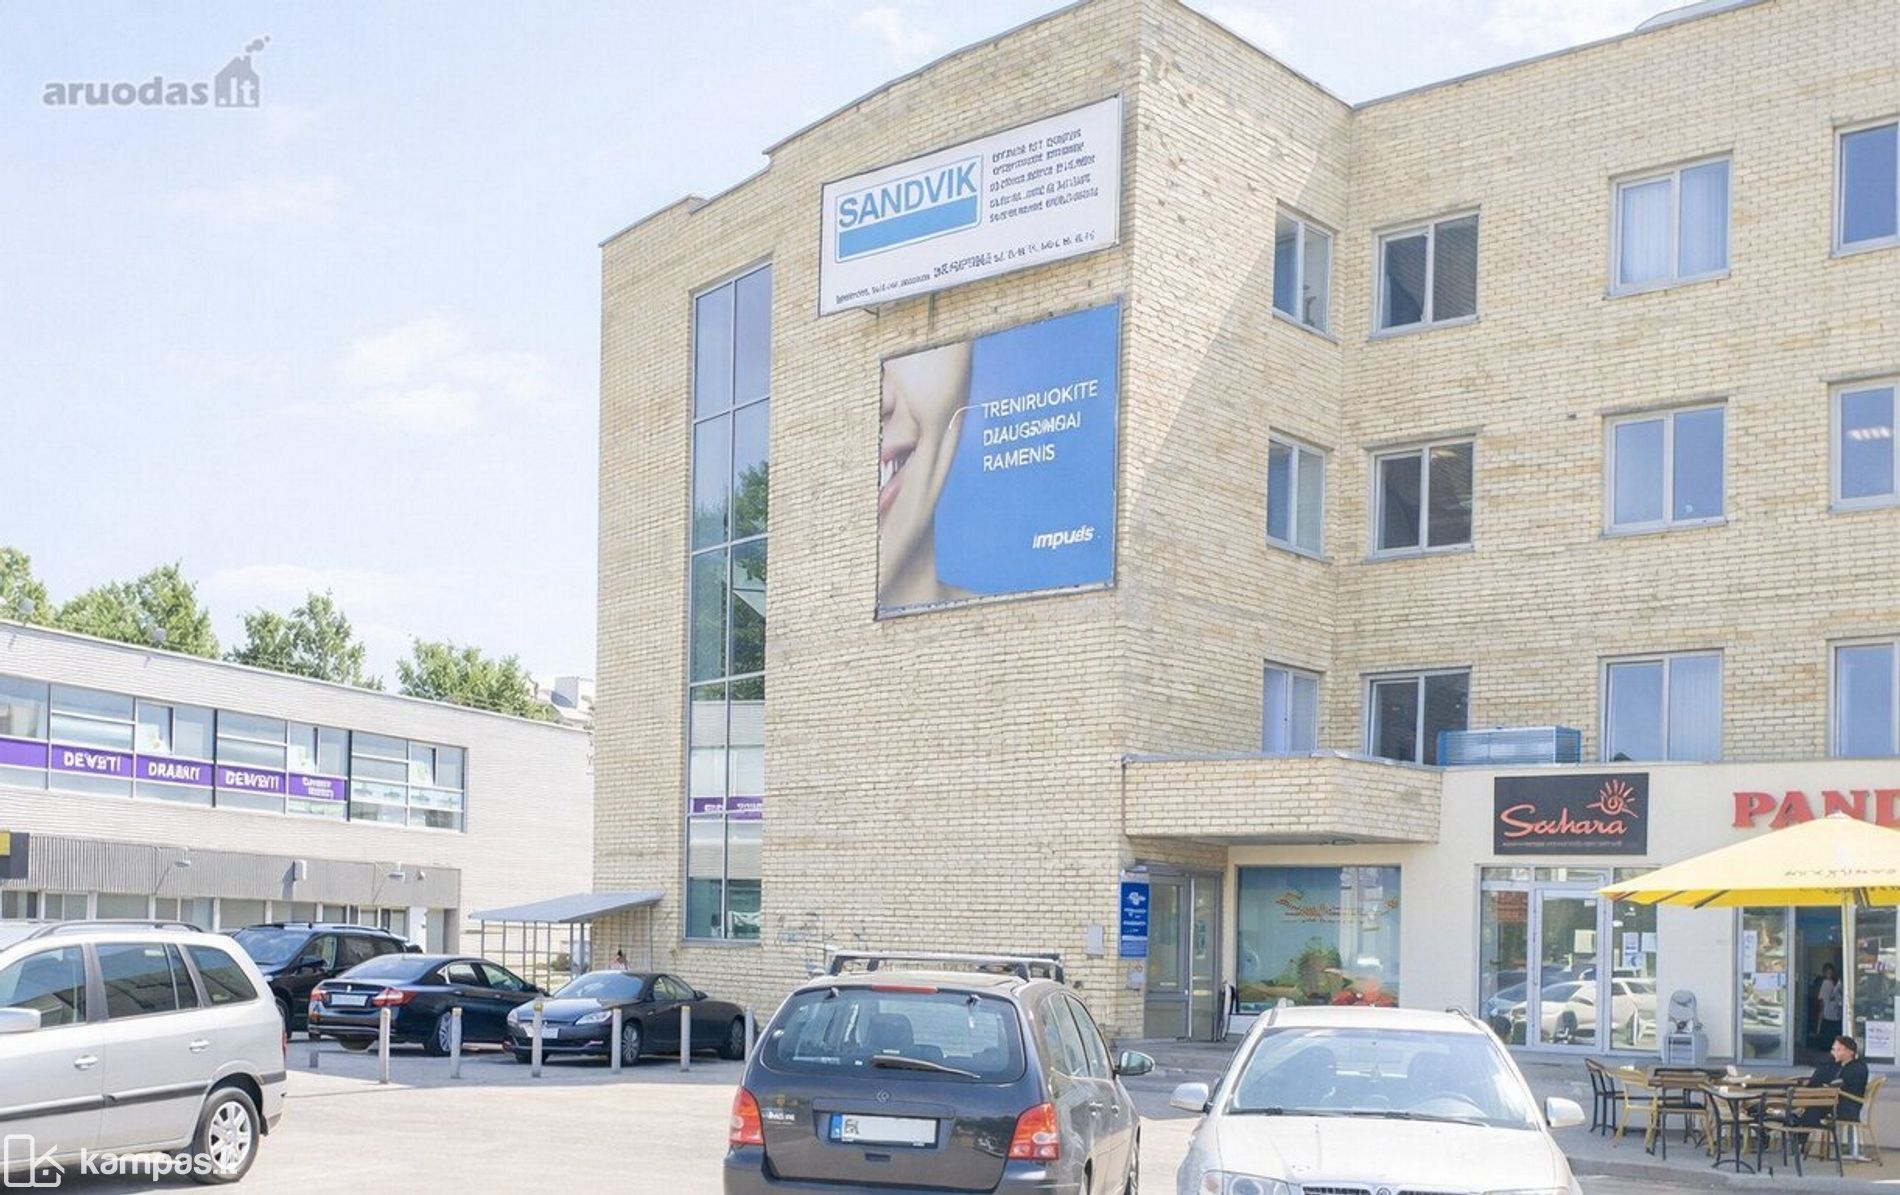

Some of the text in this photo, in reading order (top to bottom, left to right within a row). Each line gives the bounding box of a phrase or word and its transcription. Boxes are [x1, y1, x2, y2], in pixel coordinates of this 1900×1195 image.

[839, 162, 977, 228] SANDVIK
[982, 379, 1098, 419] TRENIRUOKITE
[983, 443, 1055, 472] RAMENIS
[1500, 804, 1628, 837] Sahara
